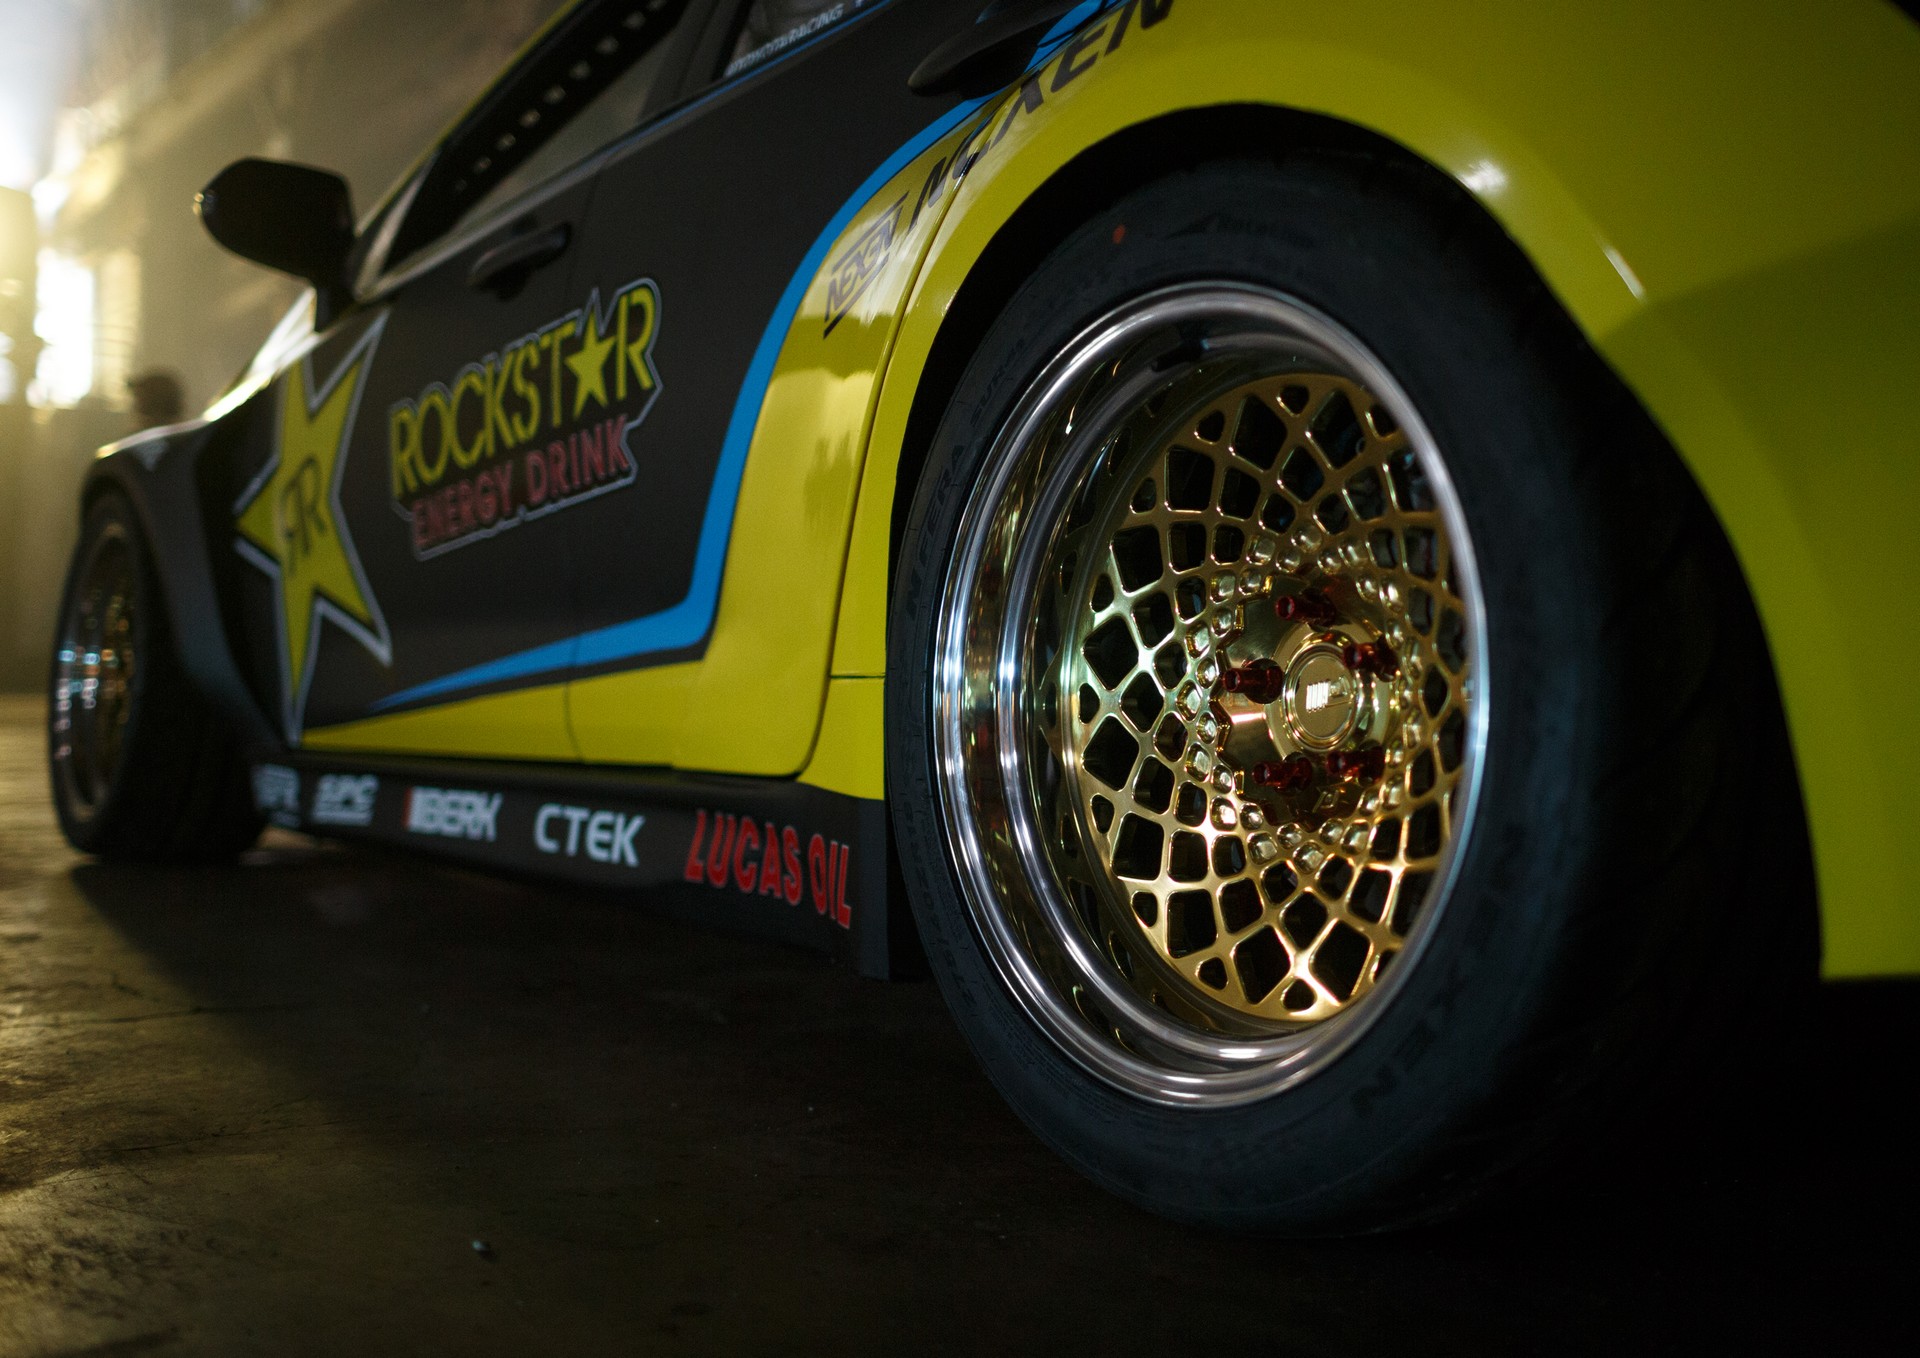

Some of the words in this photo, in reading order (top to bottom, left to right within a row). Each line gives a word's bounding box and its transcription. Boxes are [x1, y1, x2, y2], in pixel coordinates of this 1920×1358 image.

[411, 459, 514, 548] ENERGY
[525, 412, 630, 507] DRINK
[533, 802, 646, 868] CTEK
[684, 808, 804, 907] LUCAS
[807, 832, 853, 930] OIL
